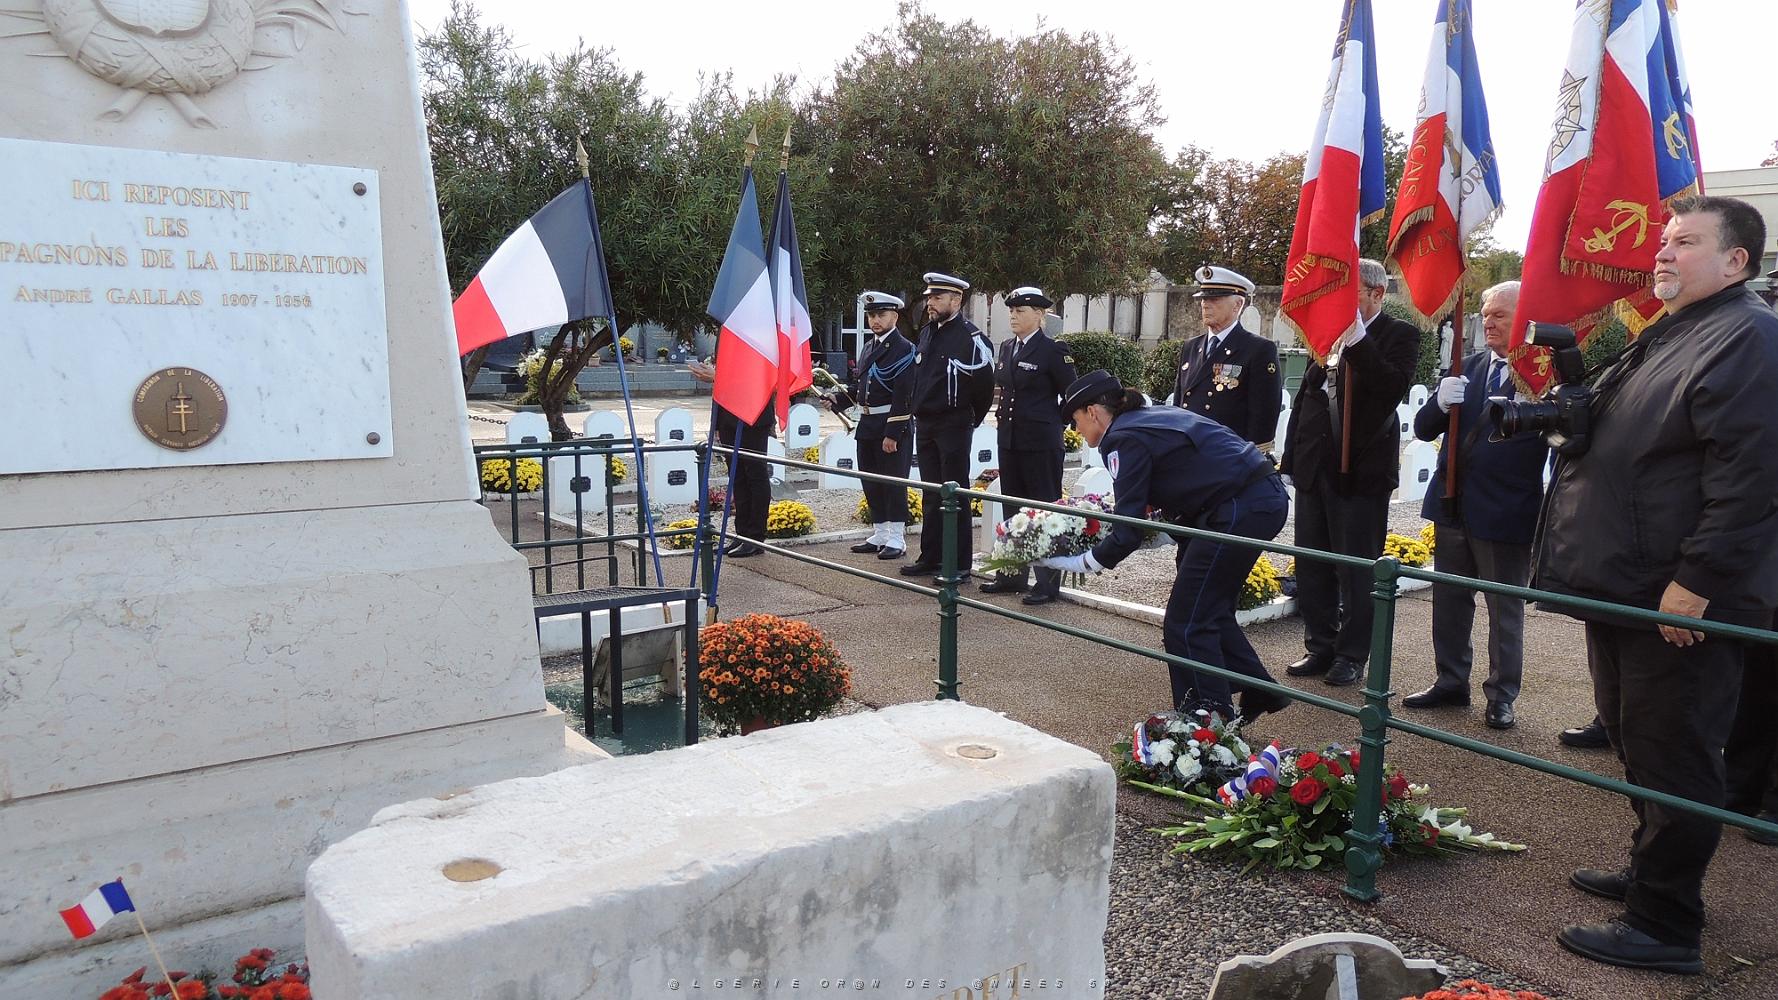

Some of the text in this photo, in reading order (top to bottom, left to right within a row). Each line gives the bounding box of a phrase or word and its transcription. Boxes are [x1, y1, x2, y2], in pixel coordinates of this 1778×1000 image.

[72, 179, 250, 210] ICI REPOSENT
[145, 216, 189, 238] LES
[0, 241, 367, 275] PAGNONS DE LA LIBERATION
[106, 287, 204, 306] GALLAS
[222, 293, 258, 307] 1907
